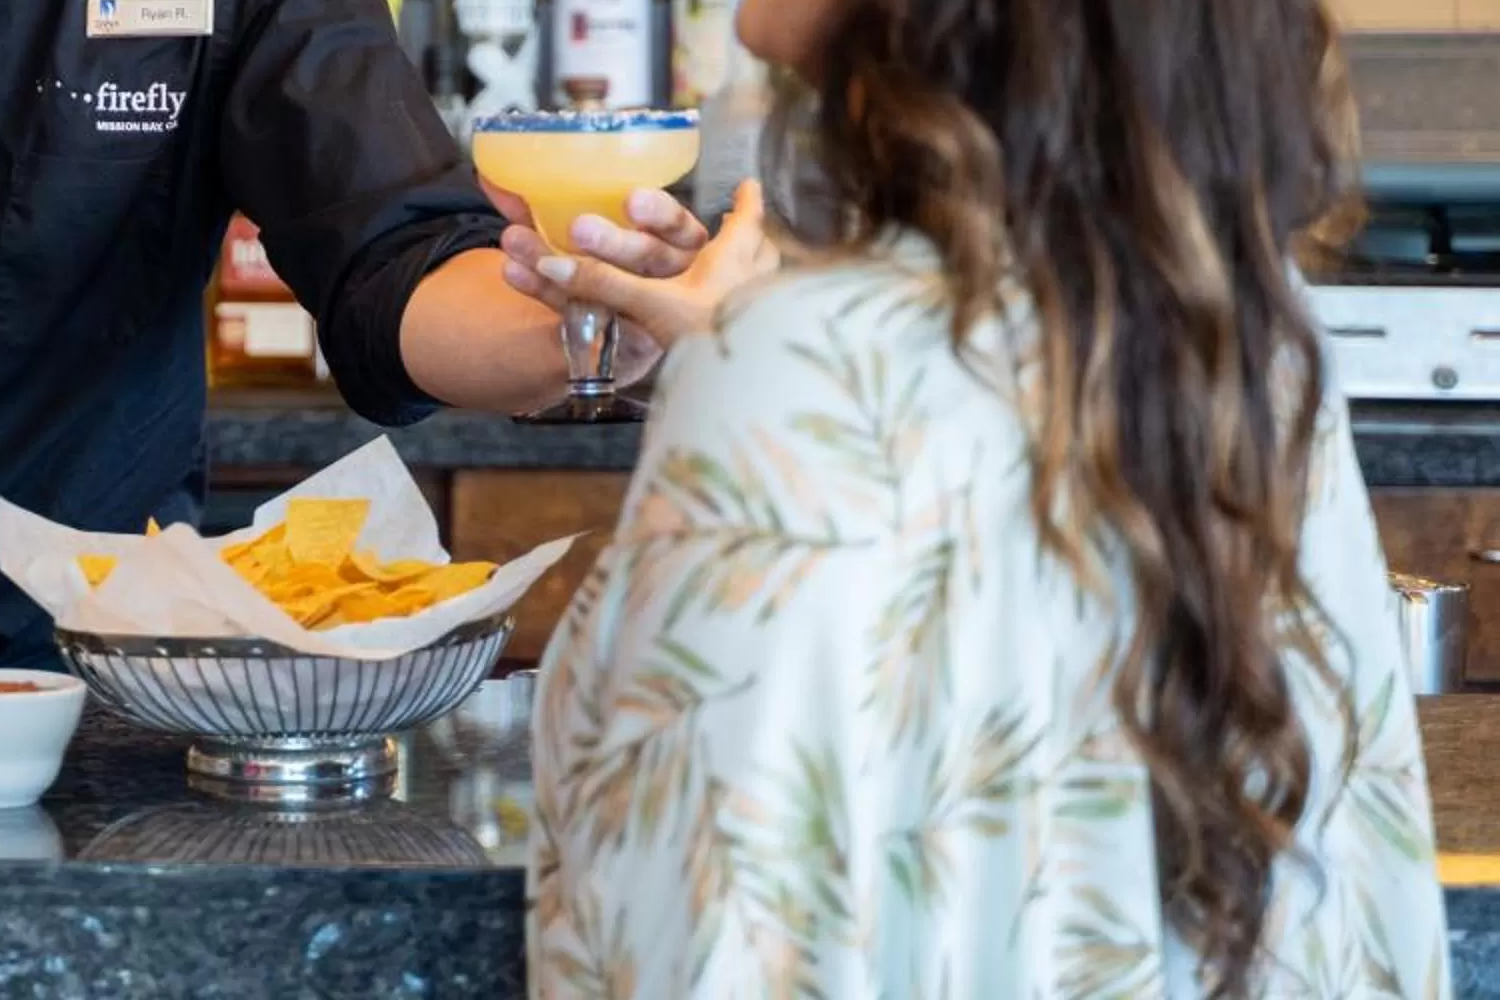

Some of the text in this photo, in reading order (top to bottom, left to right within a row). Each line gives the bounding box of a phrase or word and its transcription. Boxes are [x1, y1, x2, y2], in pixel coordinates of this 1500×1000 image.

[95, 81, 187, 120] firefly
[96, 121, 141, 131] MISSION
[141, 121, 164, 132] BAY
